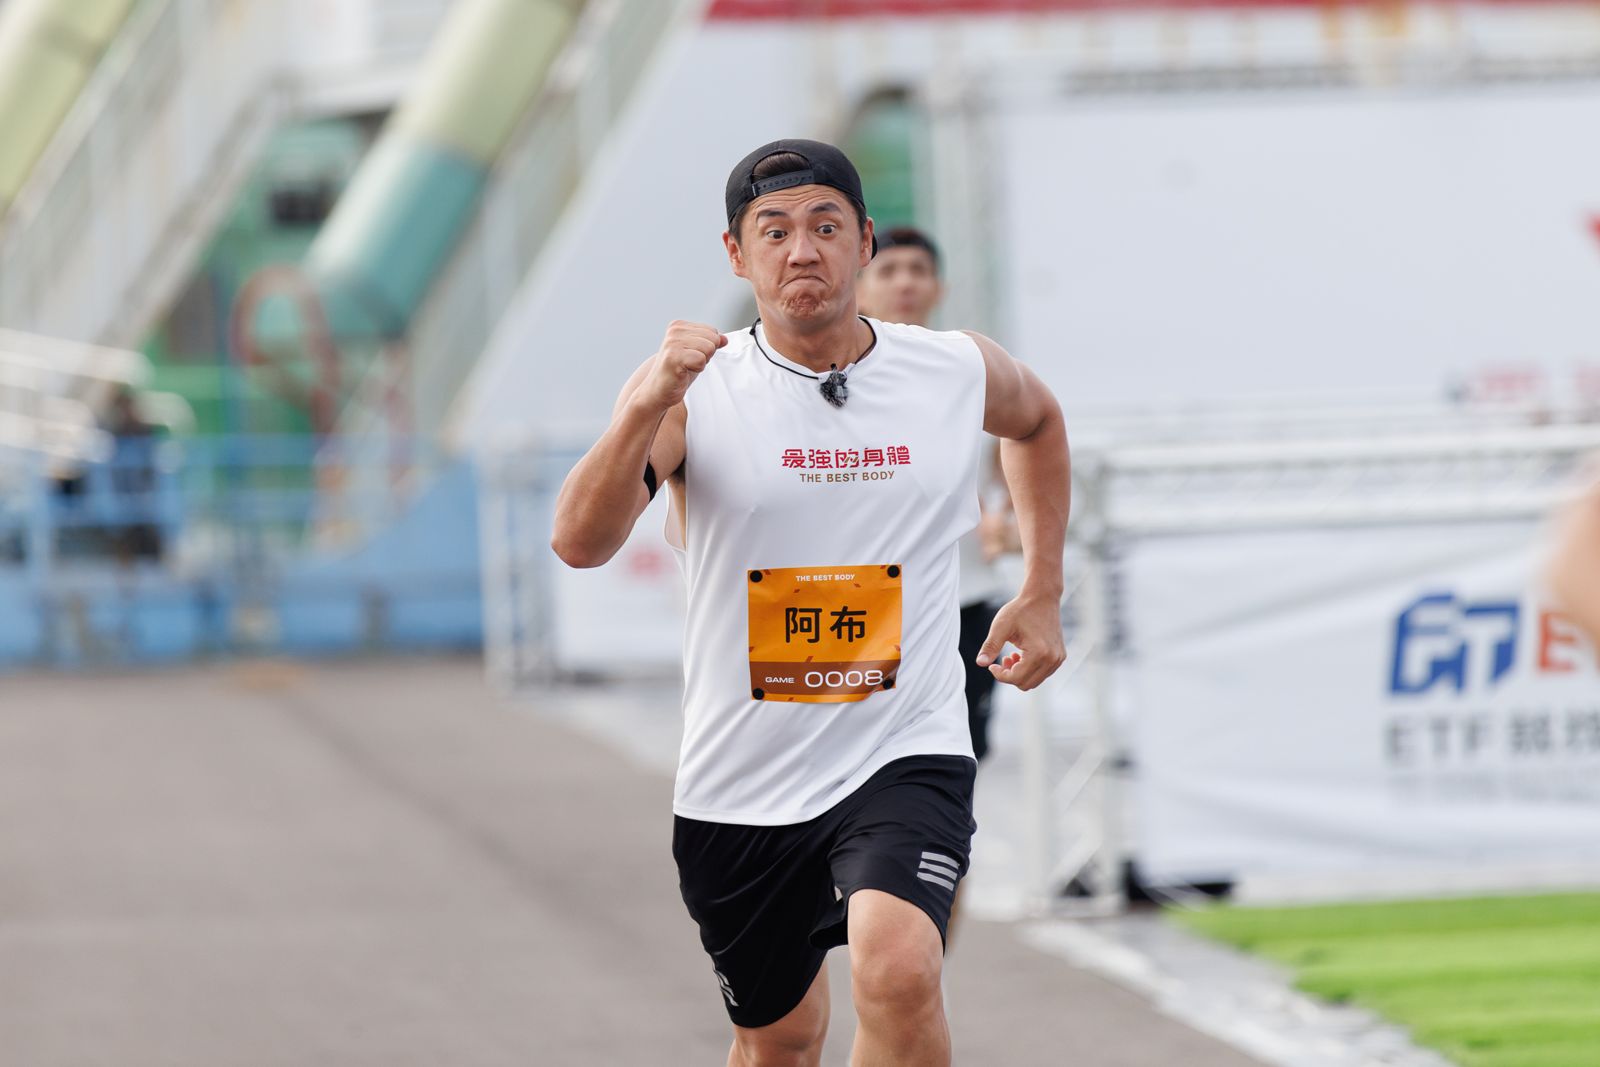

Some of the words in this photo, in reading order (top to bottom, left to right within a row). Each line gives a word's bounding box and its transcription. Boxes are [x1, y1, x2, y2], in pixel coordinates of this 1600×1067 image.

[781, 445, 911, 469] 最強的身體
[800, 473, 822, 483] THE
[826, 472, 857, 483] BEST
[862, 470, 895, 482] BODY
[813, 574, 833, 582] BEST
[834, 573, 855, 581] BODY
[785, 605, 867, 644] 阿布
[765, 676, 795, 684] GAME
[804, 669, 884, 688] 0008
